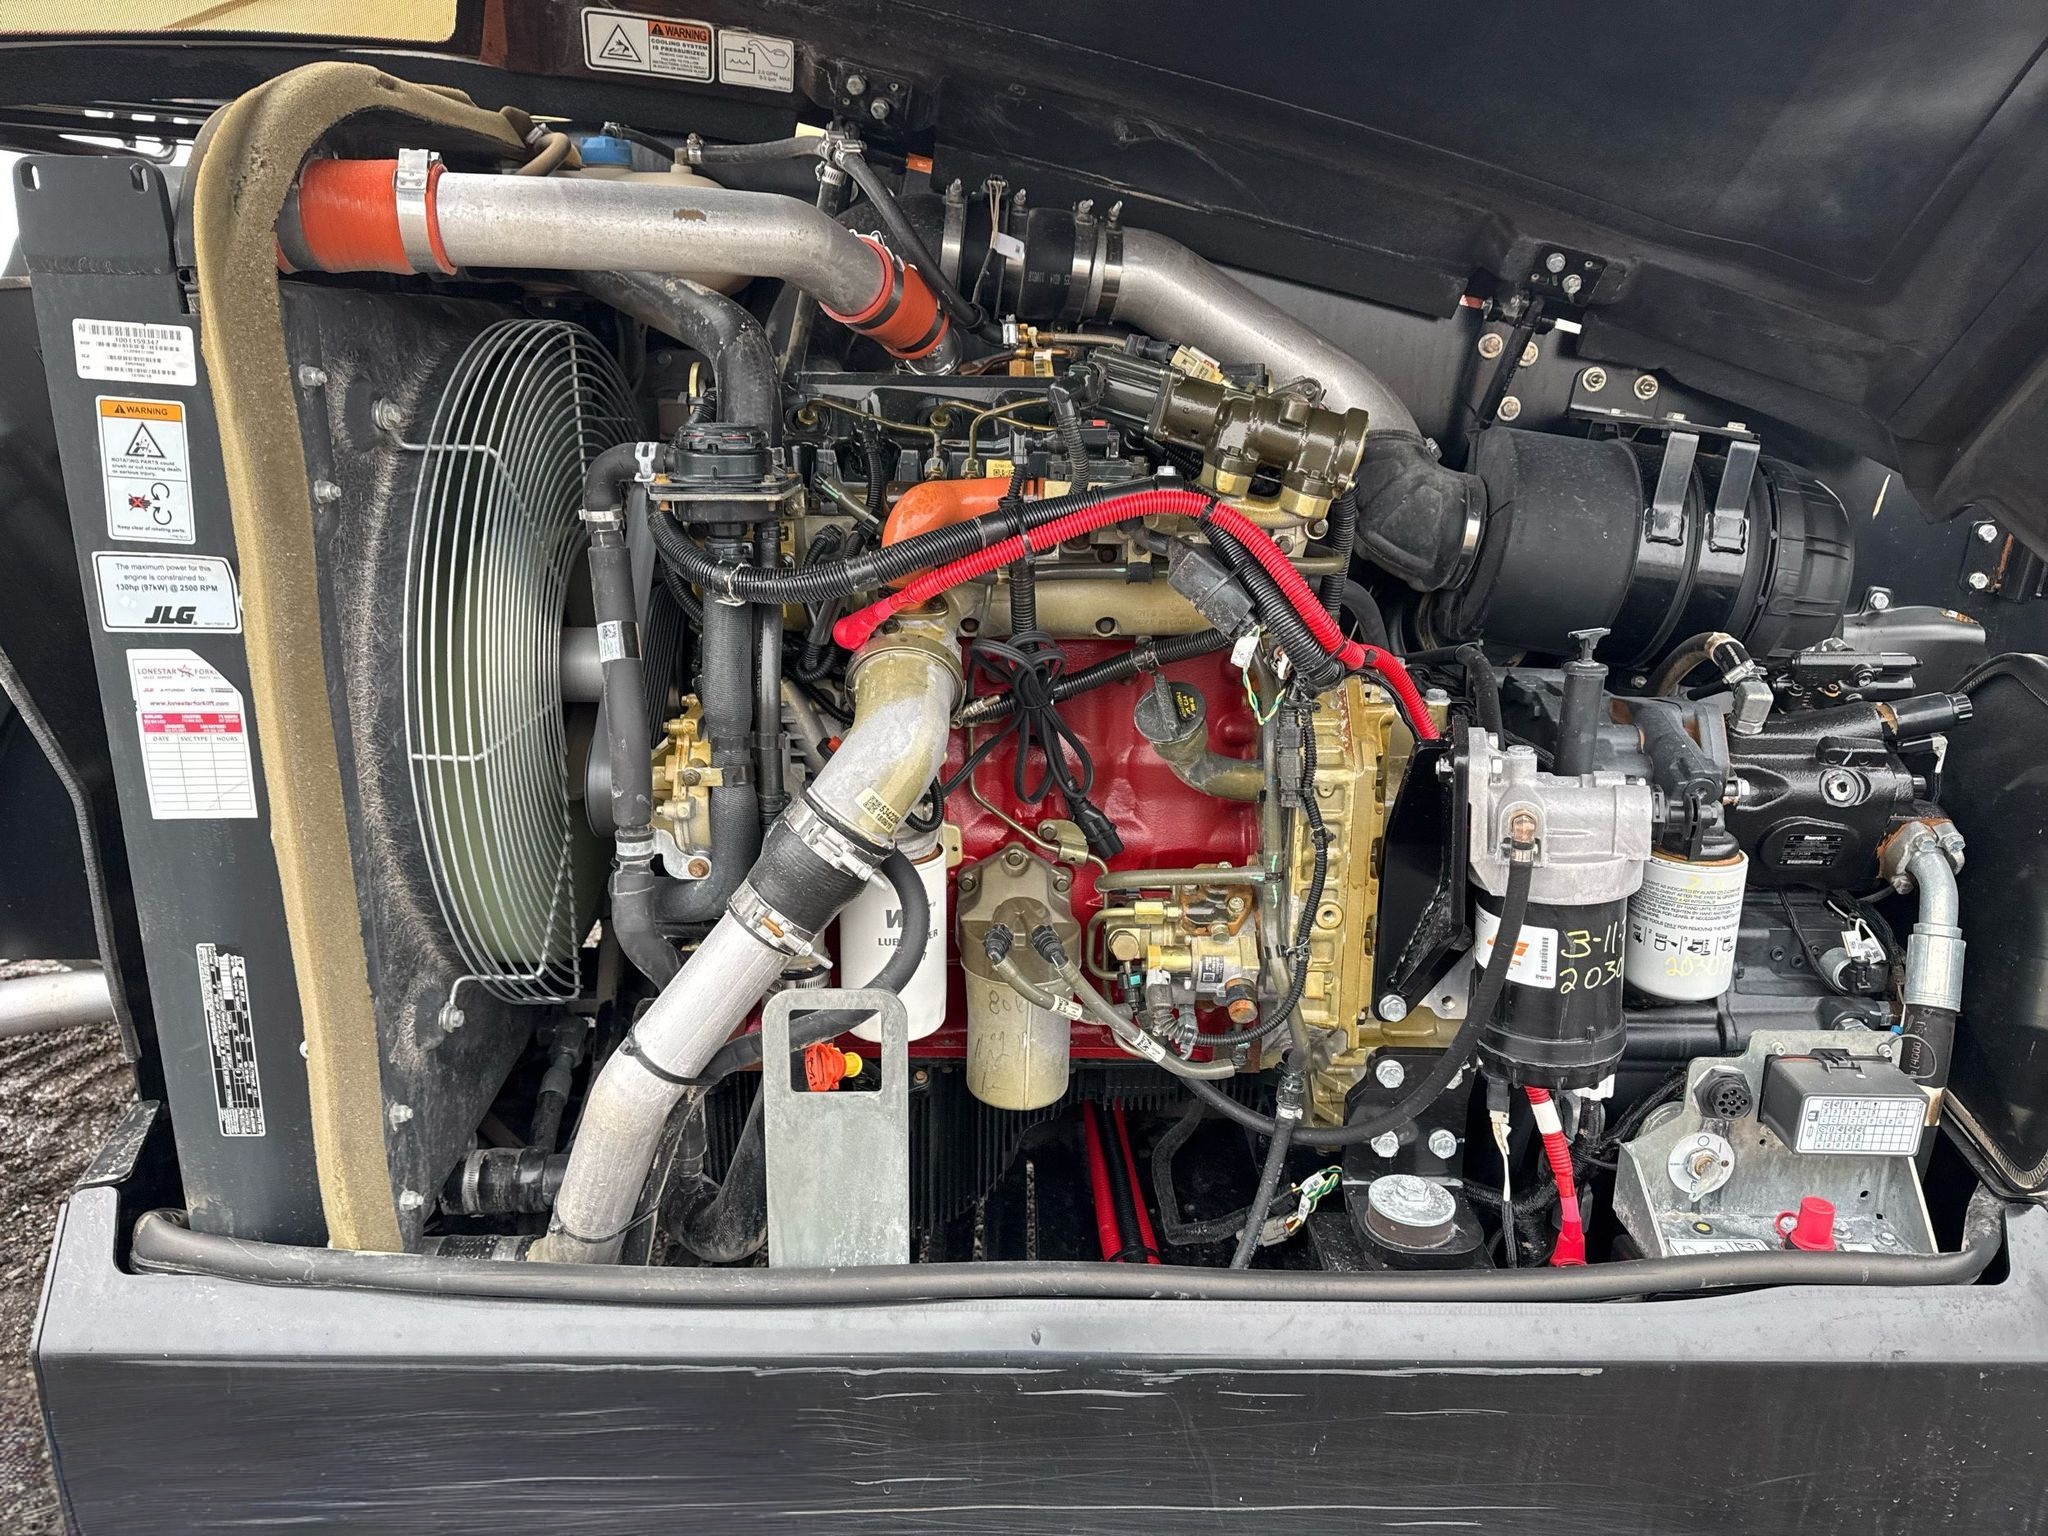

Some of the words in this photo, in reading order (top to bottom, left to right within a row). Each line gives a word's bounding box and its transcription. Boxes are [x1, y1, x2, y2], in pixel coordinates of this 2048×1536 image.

[665, 25, 707, 41] WARNING
[651, 38, 680, 47] COOLING
[682, 42, 708, 50] SYSTEM
[660, 46, 707, 57] PRESSURIZED.
[126, 405, 168, 416] WARNING
[116, 562, 129, 571] The
[124, 574, 147, 582] engine
[157, 574, 197, 582] constrained
[116, 583, 139, 593] 130hp
[141, 584, 168, 593] (97kW)
[170, 584, 178, 593] @
[180, 584, 198, 592] 2500
[200, 584, 218, 592] RPM
[144, 605, 197, 625] JLG
